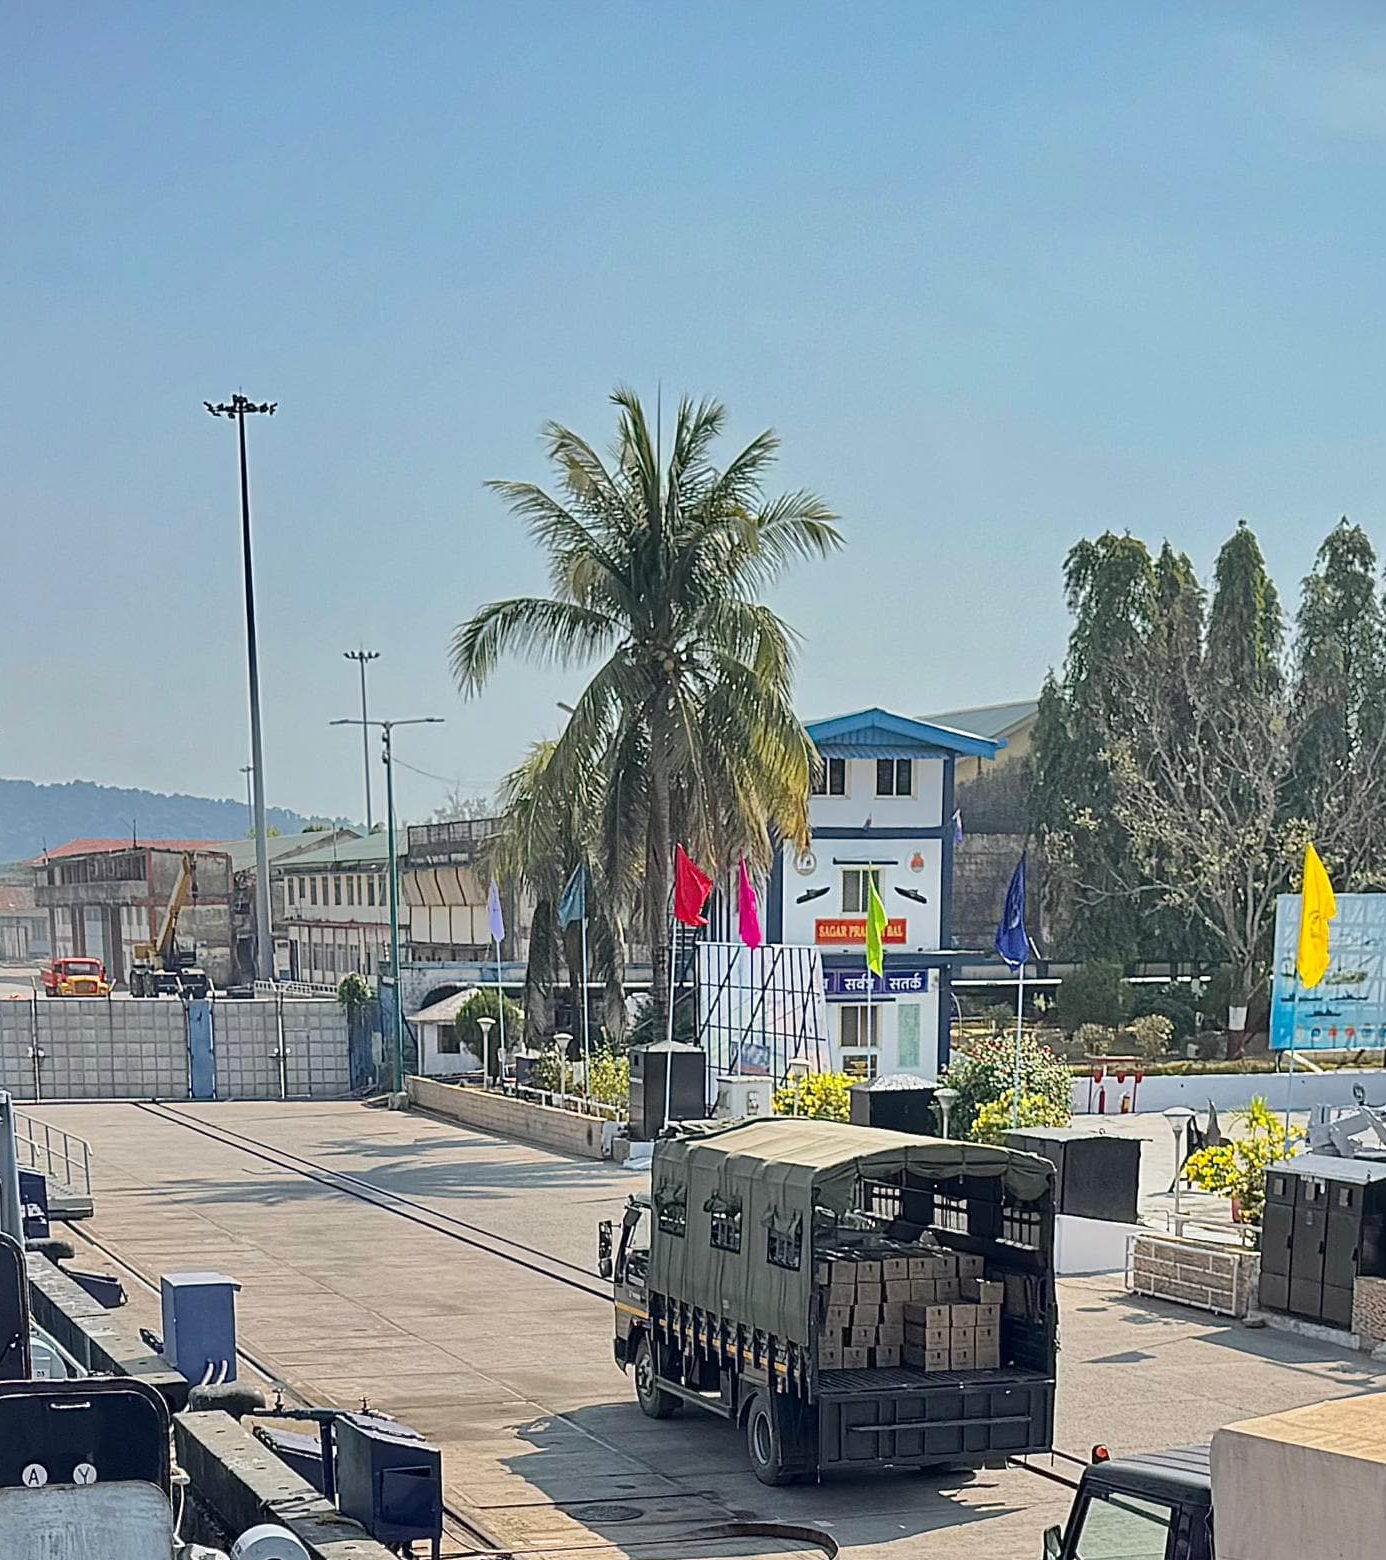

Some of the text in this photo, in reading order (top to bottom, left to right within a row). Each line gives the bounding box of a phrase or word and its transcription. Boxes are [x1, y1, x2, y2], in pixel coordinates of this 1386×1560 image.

[818, 924, 848, 938] SAGAR
[886, 925, 904, 938] BAL
[888, 972, 923, 990] सतर्क
[28, 1467, 90, 1485] A Y
